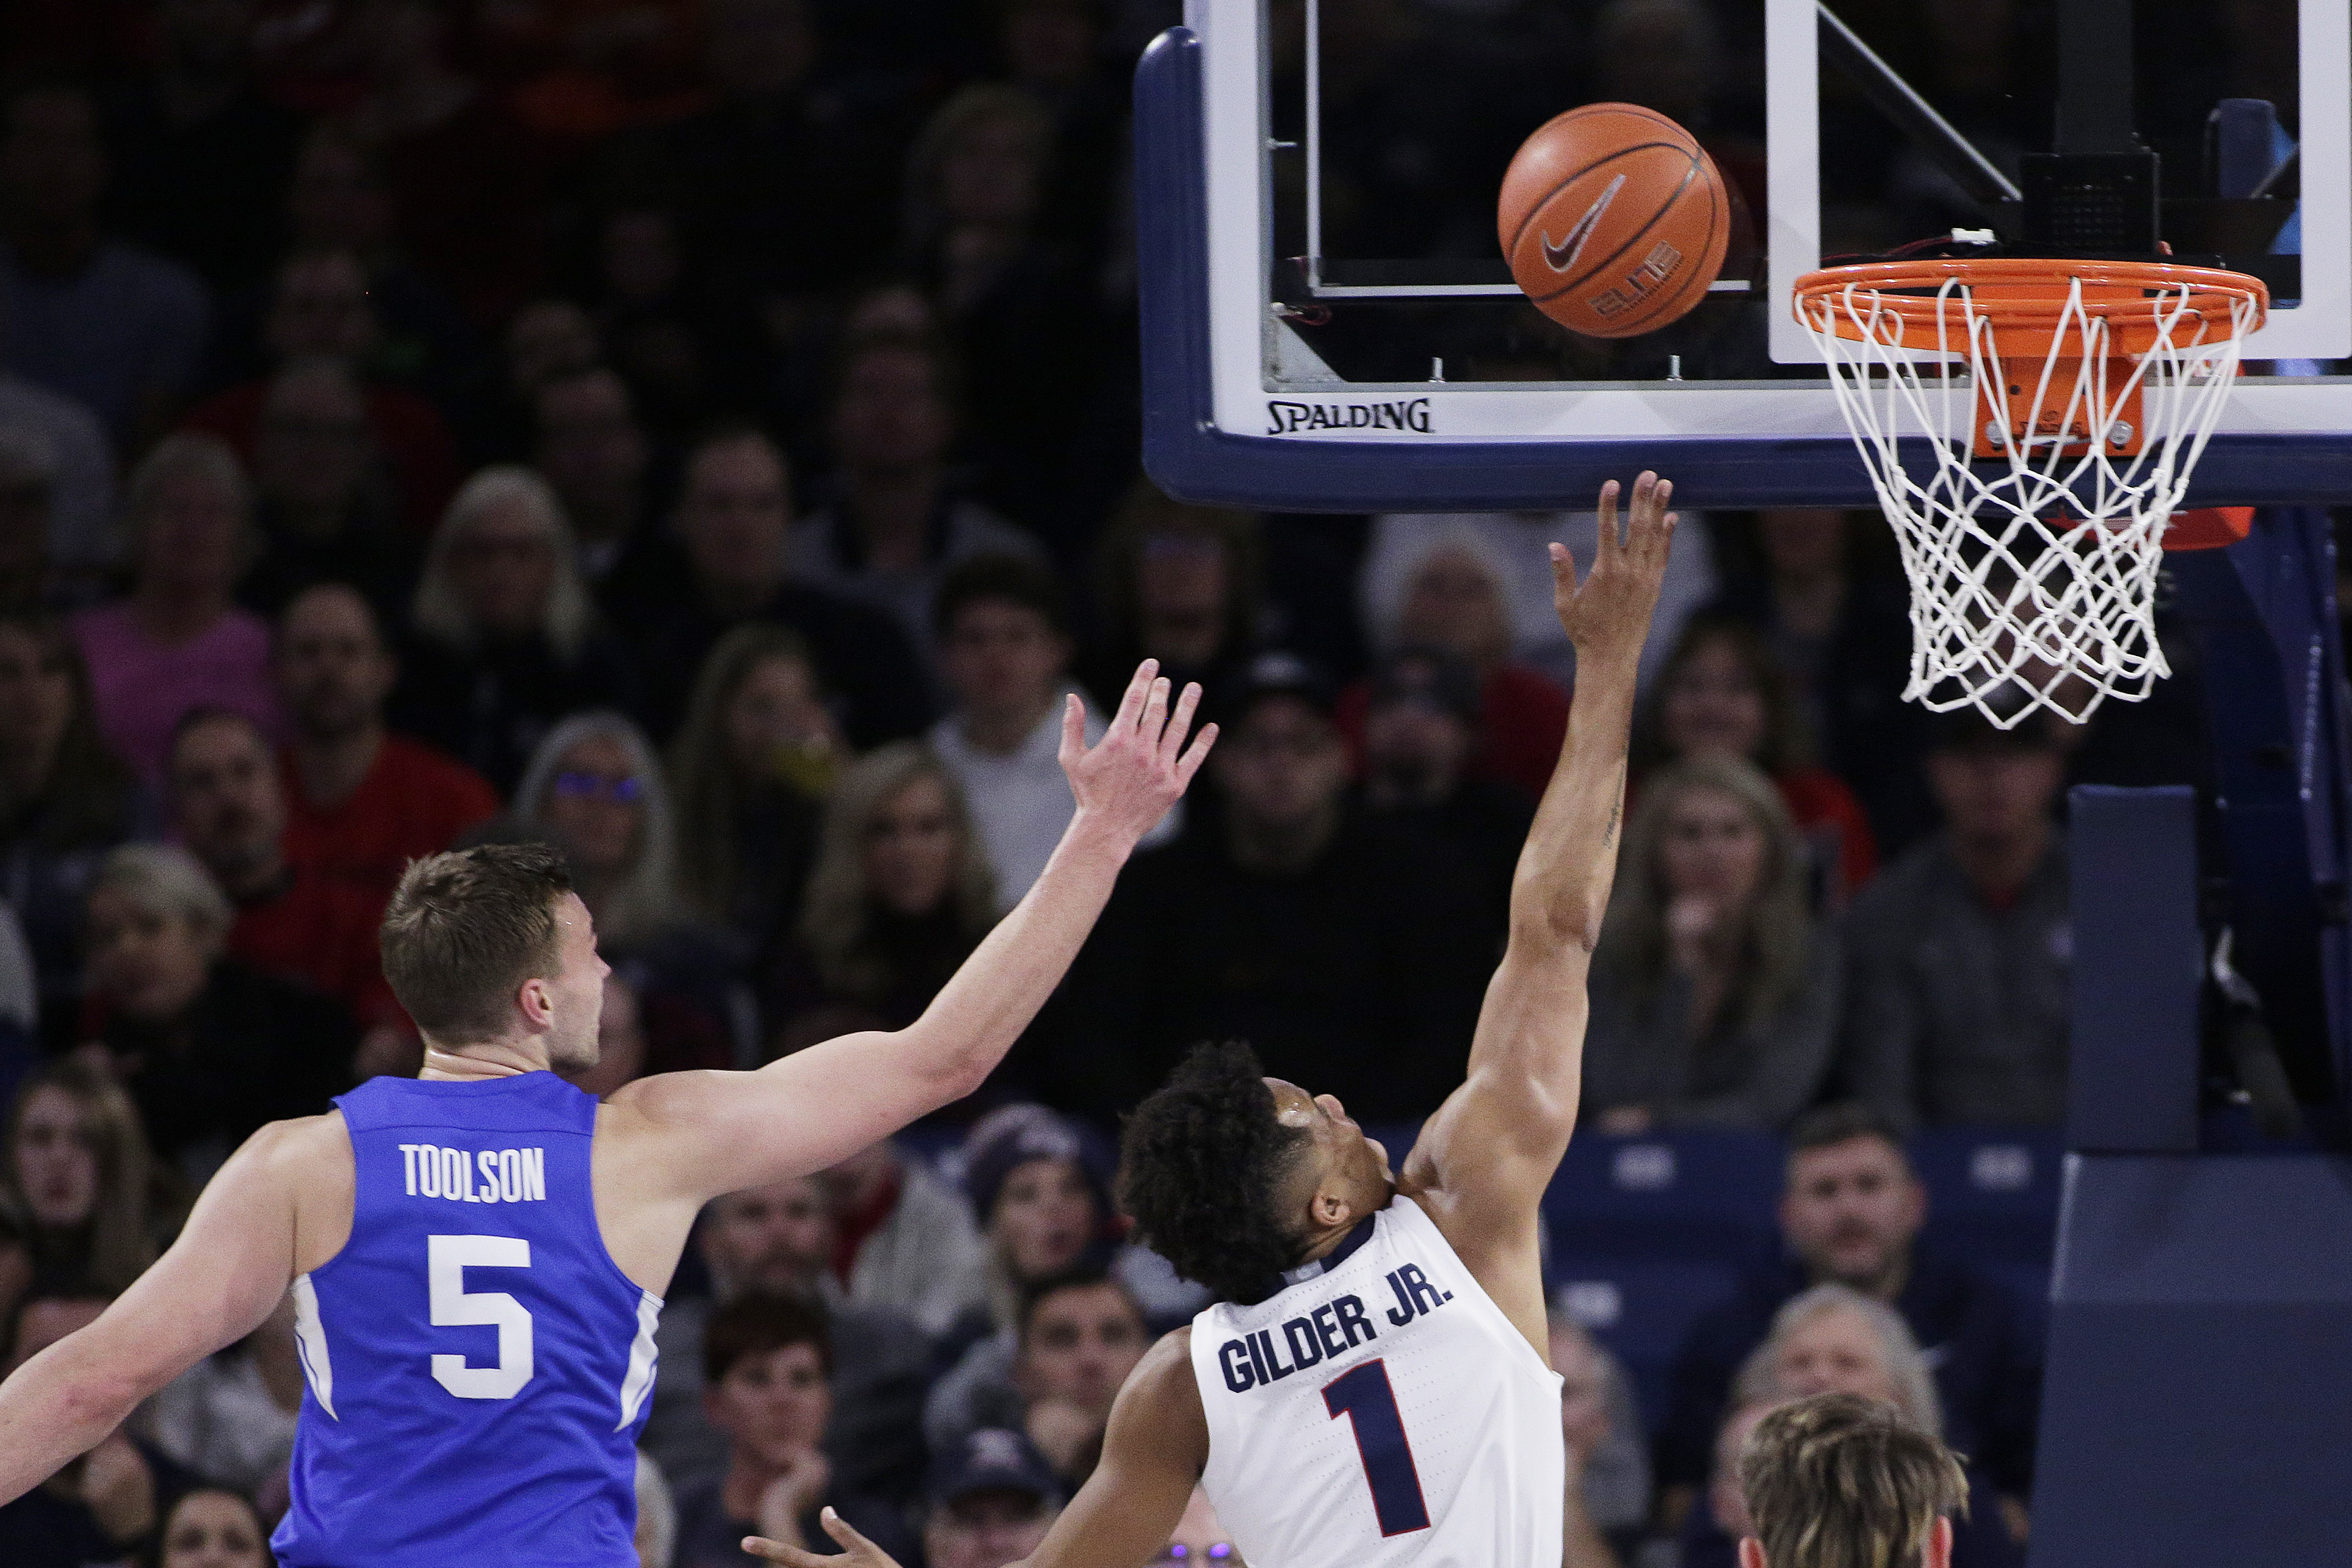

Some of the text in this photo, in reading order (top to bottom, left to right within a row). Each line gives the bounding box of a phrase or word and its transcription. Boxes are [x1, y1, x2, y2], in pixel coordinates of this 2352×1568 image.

[1588, 240, 1682, 316] ELITE
[1268, 398, 1433, 435] SPALDING
[398, 1144, 546, 1204] TOOLSON
[427, 1234, 534, 1400] 5
[1218, 1263, 1454, 1393] GILDER JR.
[1320, 1357, 1431, 1537] 1
